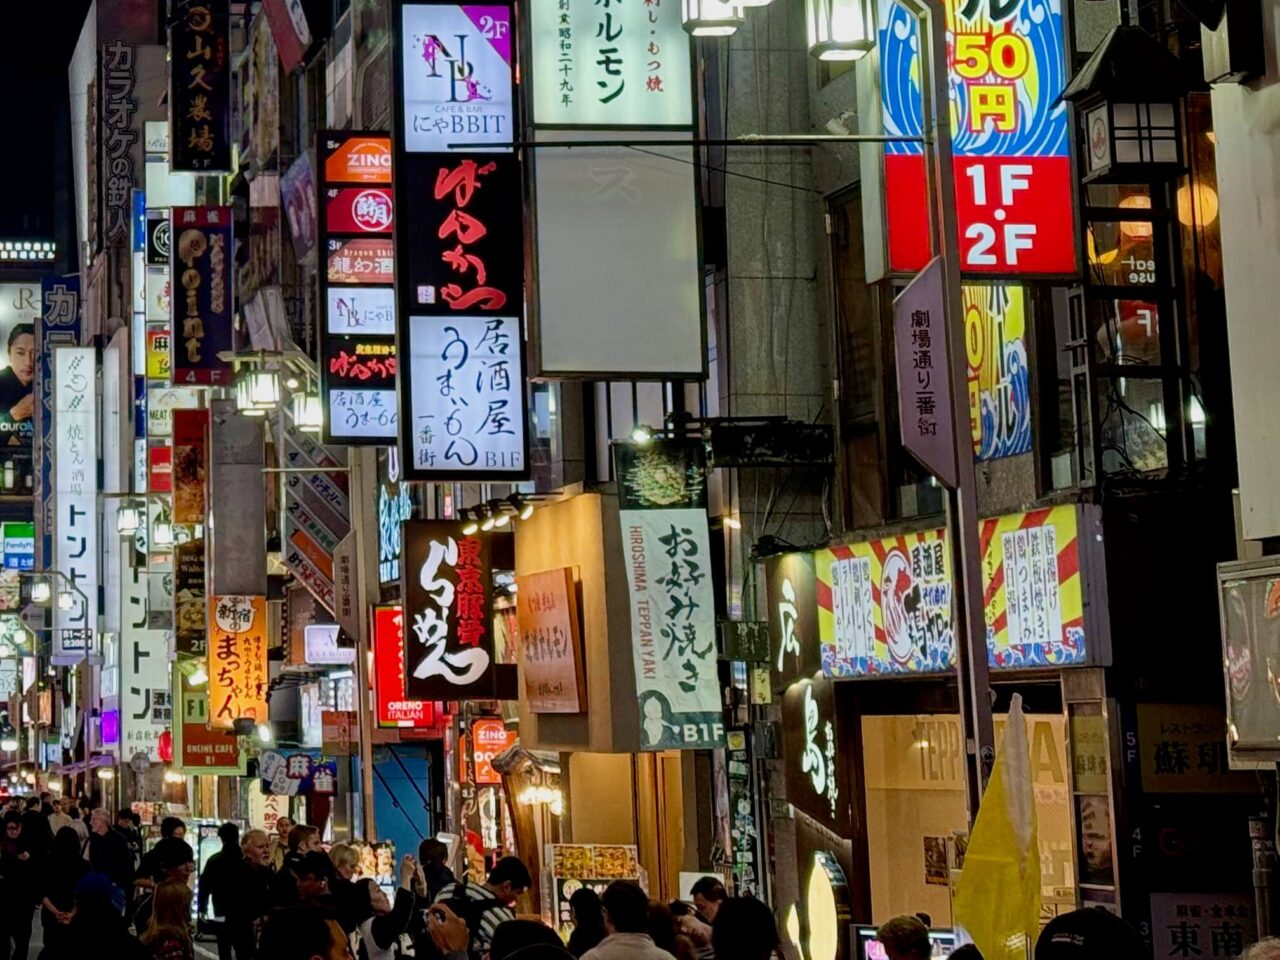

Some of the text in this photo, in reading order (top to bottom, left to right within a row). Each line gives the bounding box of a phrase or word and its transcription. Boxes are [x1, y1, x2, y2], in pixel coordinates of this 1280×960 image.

[479, 15, 510, 40] 2F
[952, 32, 1030, 134] 50 円
[413, 114, 506, 134] にゃBBIT
[966, 164, 1033, 206] 1F
[965, 223, 1037, 266] 2F
[474, 319, 516, 436] 居酒屋
[911, 309, 936, 436] 劇場通り一番街
[437, 326, 478, 467] うまいもん
[417, 414, 436, 468] 一番街
[485, 451, 521, 468] B1F
[630, 526, 649, 592] HIROSHIMA
[654, 524, 713, 694] お好み焼き
[387, 710, 423, 720] ITALIAN
[388, 701, 423, 710] ORENO
[683, 723, 725, 742] B1F
